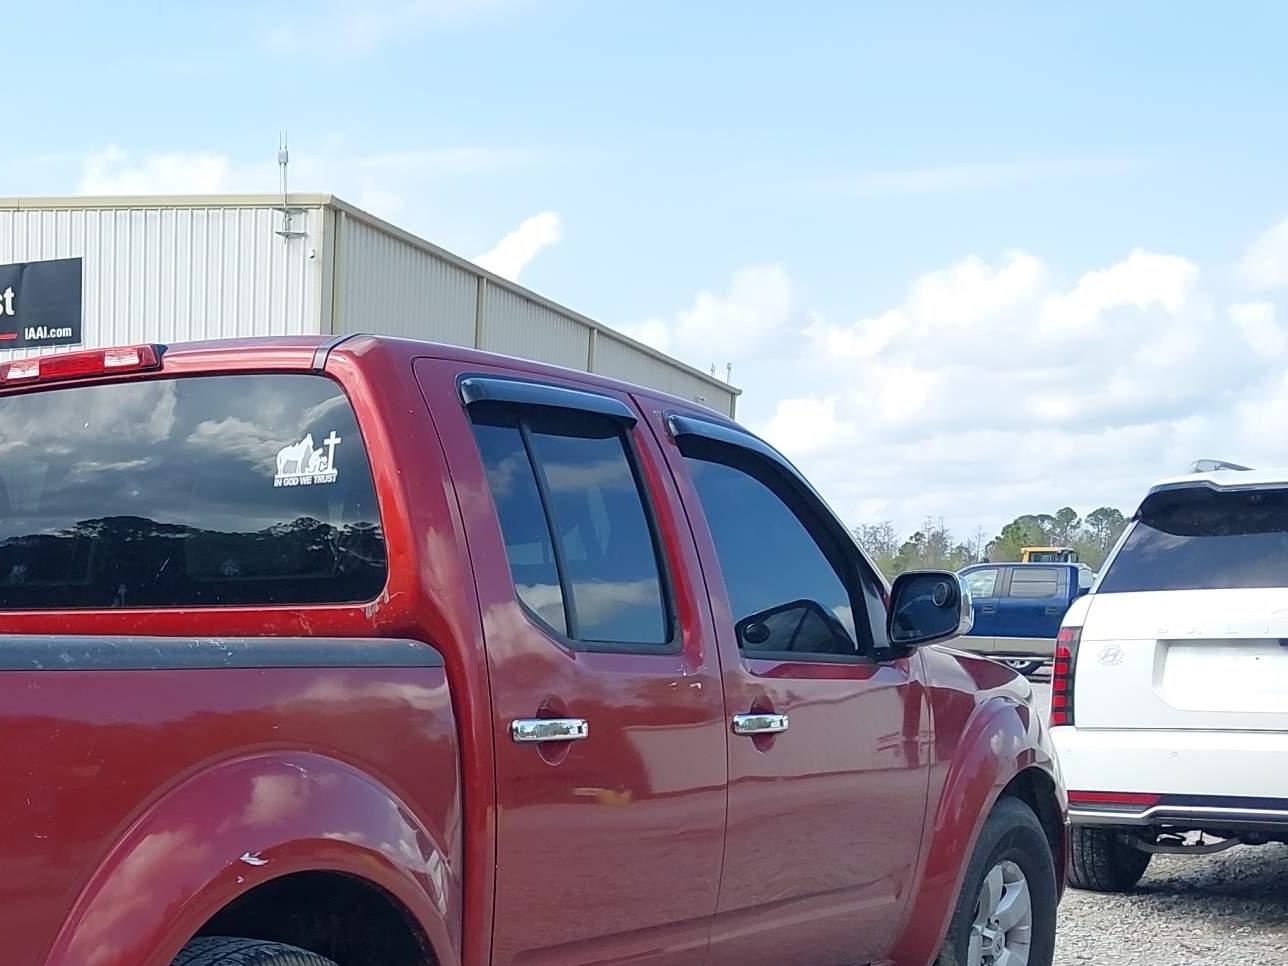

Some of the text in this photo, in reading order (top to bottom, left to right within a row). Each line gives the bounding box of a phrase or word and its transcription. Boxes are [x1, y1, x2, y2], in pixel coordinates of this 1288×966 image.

[274, 475, 336, 487] IN GOD WE TRUST
